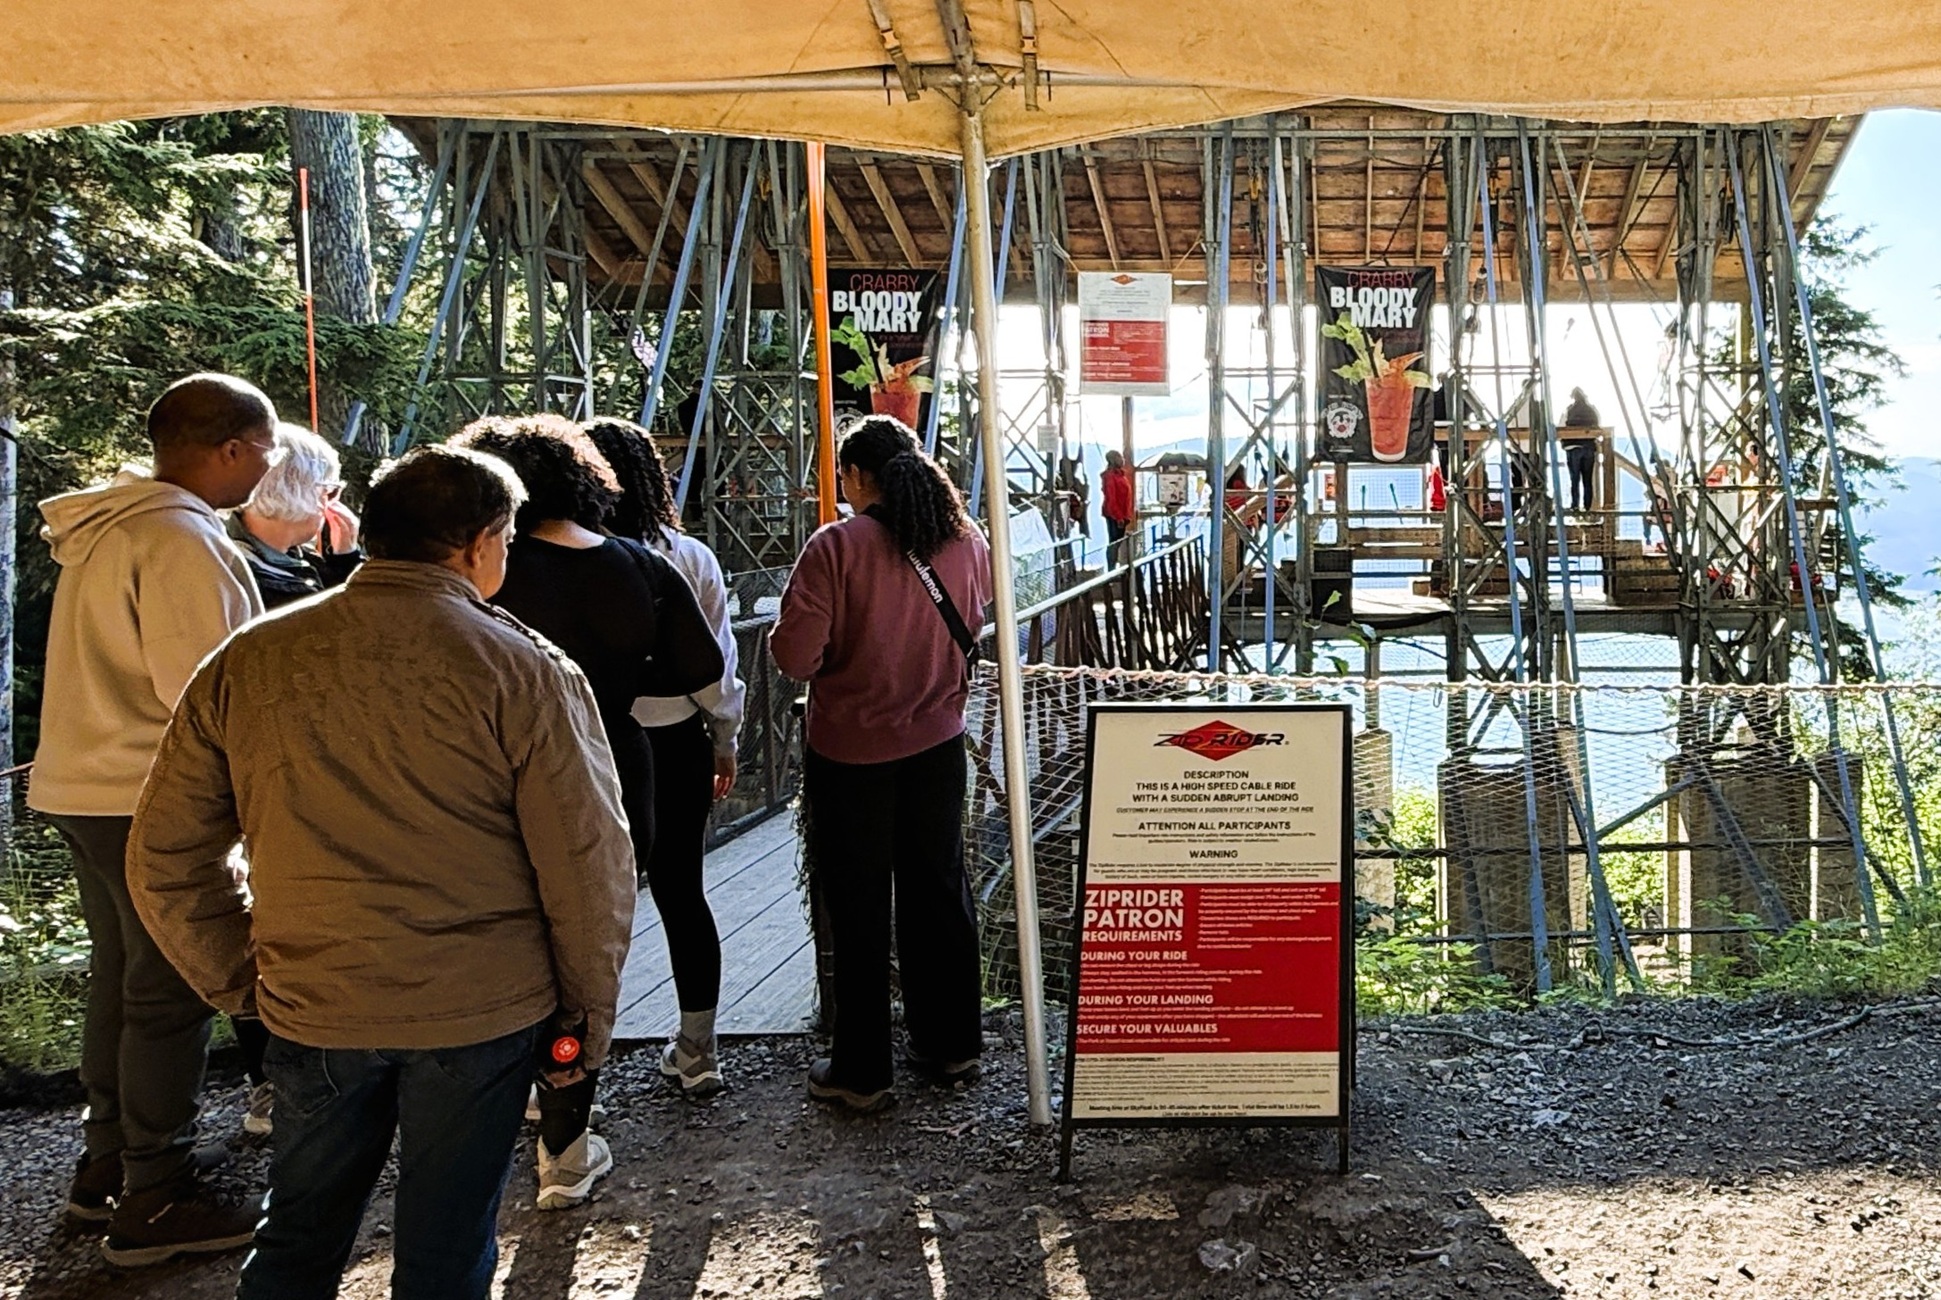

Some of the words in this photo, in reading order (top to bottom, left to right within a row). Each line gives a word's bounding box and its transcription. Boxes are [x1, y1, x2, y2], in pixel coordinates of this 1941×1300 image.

[850, 273, 920, 292] CRABBY
[1347, 271, 1416, 288] CRABBY
[832, 290, 923, 313] BLOODY
[1329, 286, 1418, 309] BLOODY
[853, 310, 923, 333] MARY
[1350, 306, 1418, 328] MARY
[906, 548, 944, 604] lululemon
[1183, 770, 1250, 780] DESCRIPTION
[1136, 782, 1158, 791] THIS
[1160, 782, 1170, 791] IS
[1171, 782, 1179, 791] A
[1180, 782, 1206, 791] HIGH
[1207, 782, 1239, 791] SPEED
[1240, 782, 1272, 791] CABLE
[1274, 782, 1297, 791] RIDE
[1132, 793, 1159, 803] WITH
[1161, 793, 1169, 803] A
[1170, 793, 1211, 803] SUDDEN
[1213, 793, 1252, 803] ABRUPT
[1254, 793, 1300, 803] LANDING
[1138, 821, 1196, 831] ATTENTION
[1197, 821, 1216, 831] ALL
[1218, 821, 1292, 831] PARTICIPANTS
[1189, 849, 1239, 859] WARNING
[1084, 888, 1184, 908] ZIPRIDER
[1083, 908, 1184, 929] PATRON
[1081, 930, 1183, 943] REQUIREMENTS
[1080, 950, 1126, 962] DURING
[1127, 950, 1161, 962] YOUR
[1162, 950, 1188, 962] RIDE
[1077, 994, 1124, 1006] DURING
[1125, 994, 1159, 1006] YOUR
[1160, 994, 1215, 1006] LANDING
[1076, 1023, 1118, 1035] SECURE
[1119, 1023, 1152, 1035] YOUR
[1154, 1023, 1218, 1035] VALUABLES
